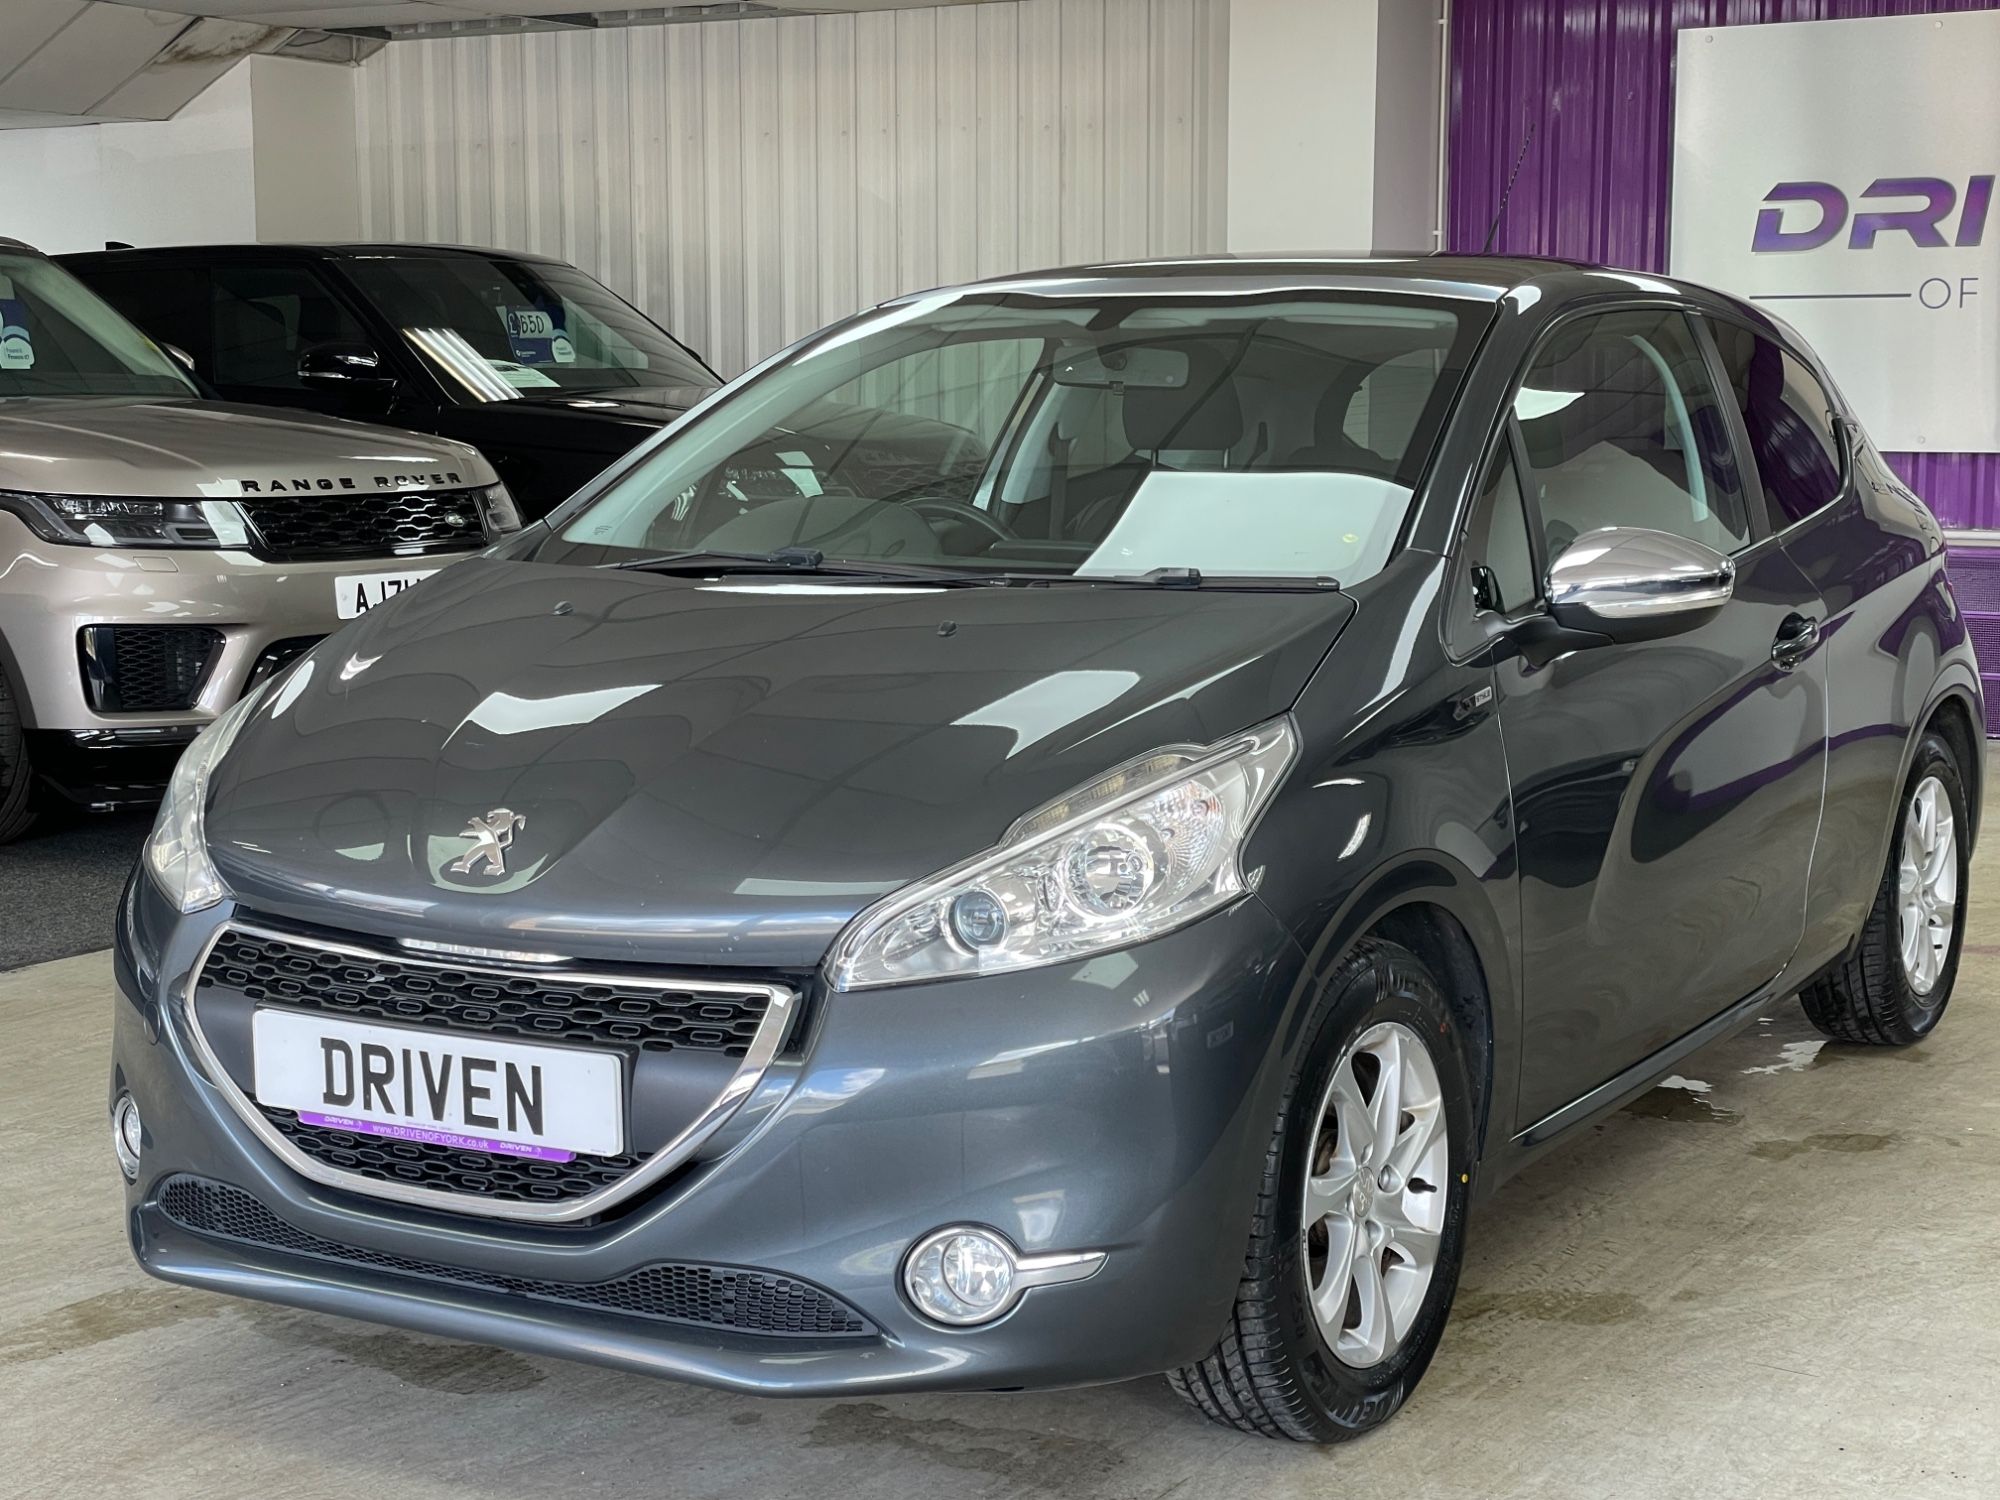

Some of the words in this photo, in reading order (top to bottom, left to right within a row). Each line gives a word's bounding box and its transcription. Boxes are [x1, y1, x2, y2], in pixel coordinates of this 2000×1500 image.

[1919, 277, 1979, 309] OF
[241, 477, 356, 492] RANGE
[374, 472, 462, 488] ROVER
[320, 1037, 544, 1137] DRIVEN
[372, 1124, 489, 1150] www.DRIVENOFYORK.co.uk
[499, 1141, 533, 1153] DRIVEN
